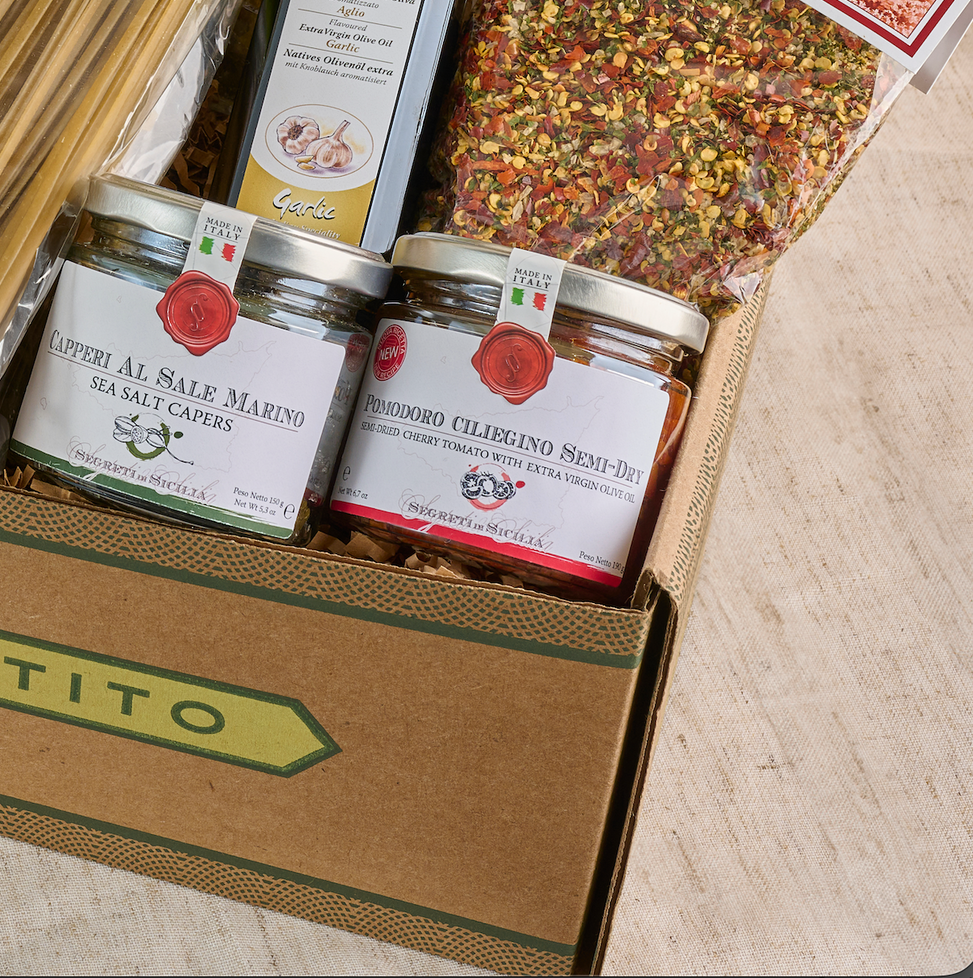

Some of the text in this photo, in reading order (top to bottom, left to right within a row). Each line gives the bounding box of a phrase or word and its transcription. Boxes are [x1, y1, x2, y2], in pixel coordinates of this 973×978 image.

[336, 5, 365, 18] Aglio
[329, 18, 368, 32] Flavoured
[326, 39, 360, 53] Garlic
[352, 33, 393, 48] Olive Oil
[283, 48, 394, 77] Natives Olivenöl extra
[272, 188, 335, 220] Garlic
[203, 224, 241, 241] ITALY
[205, 216, 244, 233] MADE IN
[513, 275, 551, 289] ITALY
[514, 267, 552, 281] MADE IN
[379, 345, 399, 360] NEW
[49, 329, 112, 370] CAPPERI
[155, 366, 217, 403] SALE
[225, 387, 305, 428] MARINO
[90, 375, 234, 433] SEA SALT CAPERS
[364, 393, 445, 428] POMODORO
[452, 415, 554, 456] CILIEGINO
[559, 443, 644, 485] SEMI-DRY
[75, 448, 136, 480] SEGRETI
[361, 421, 636, 504] SEMI-DRIED CHERRY TOMATO WITH EXTRA VIRGIN OLIVE OIL
[233, 486, 269, 502] Peso Netto
